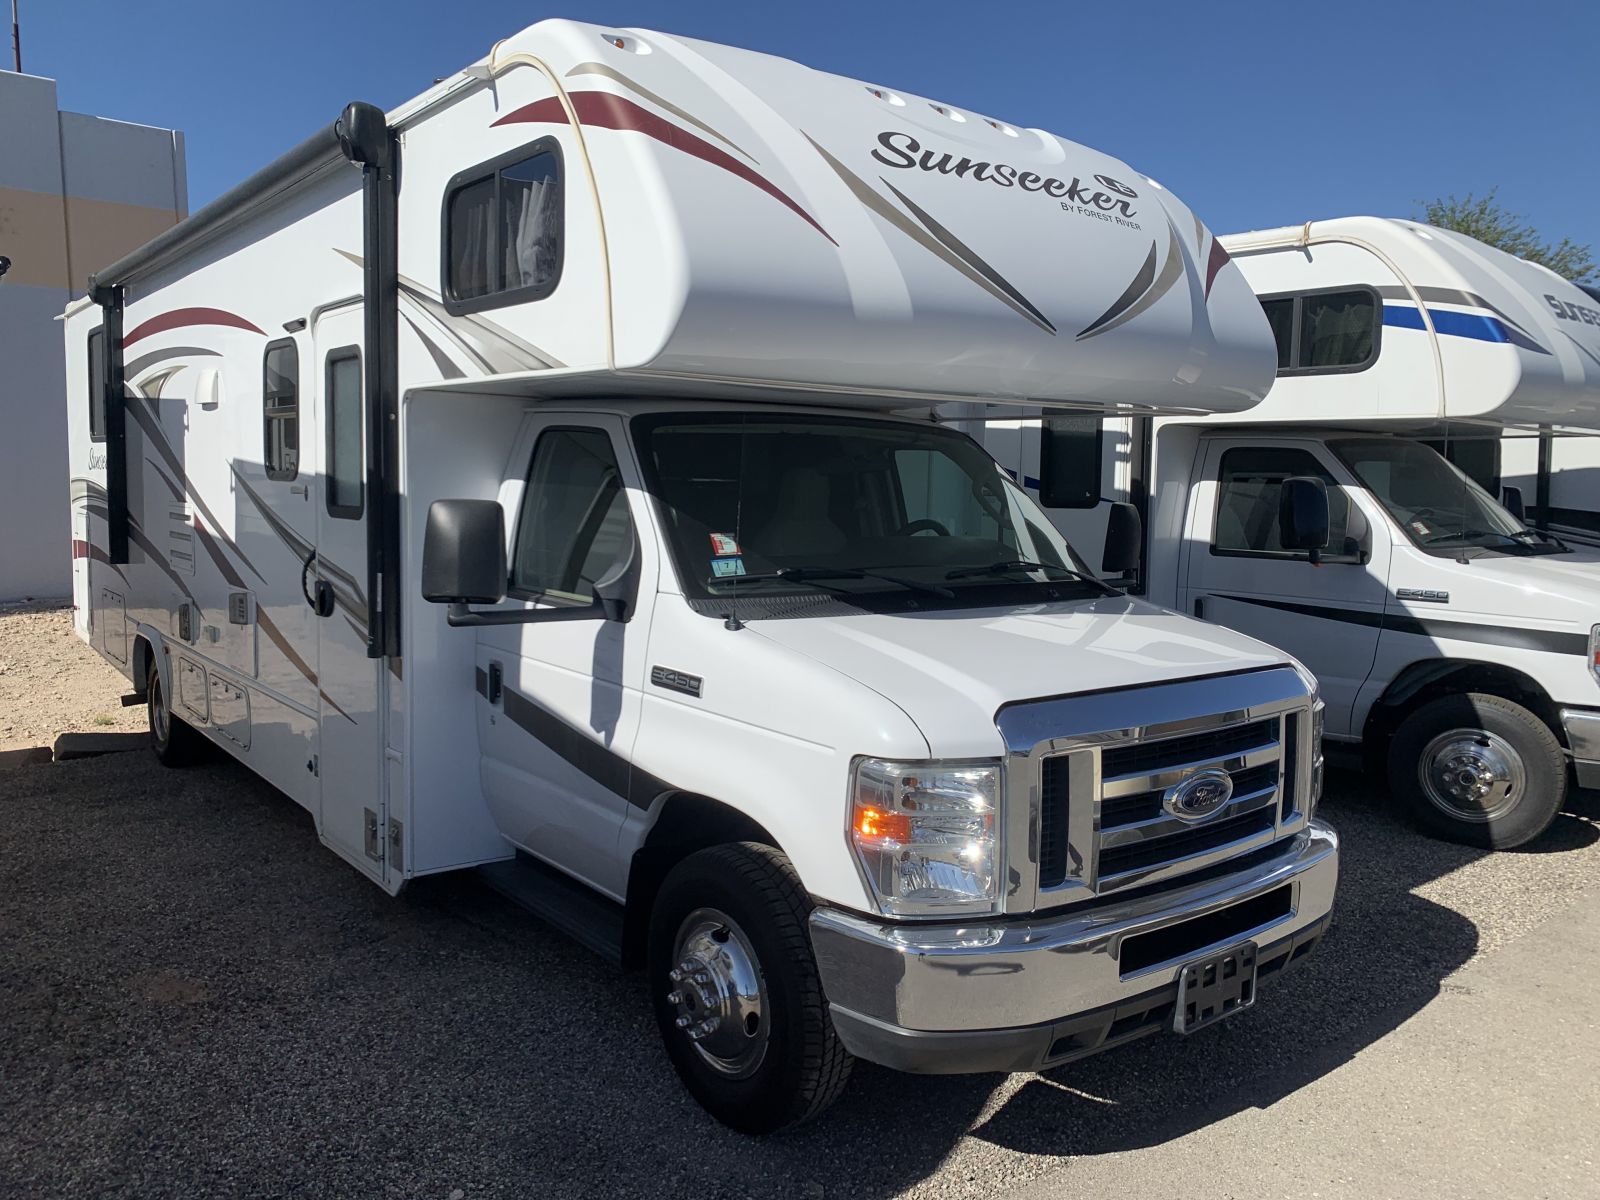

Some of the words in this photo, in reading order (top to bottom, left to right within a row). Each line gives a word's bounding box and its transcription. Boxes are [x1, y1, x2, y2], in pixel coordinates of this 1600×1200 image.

[871, 131, 1137, 218] Sunseeker
[1060, 202, 1074, 213] BY
[1077, 206, 1113, 223] FOREST
[1114, 216, 1141, 231] RIVER
[1193, 784, 1223, 807] Ford
